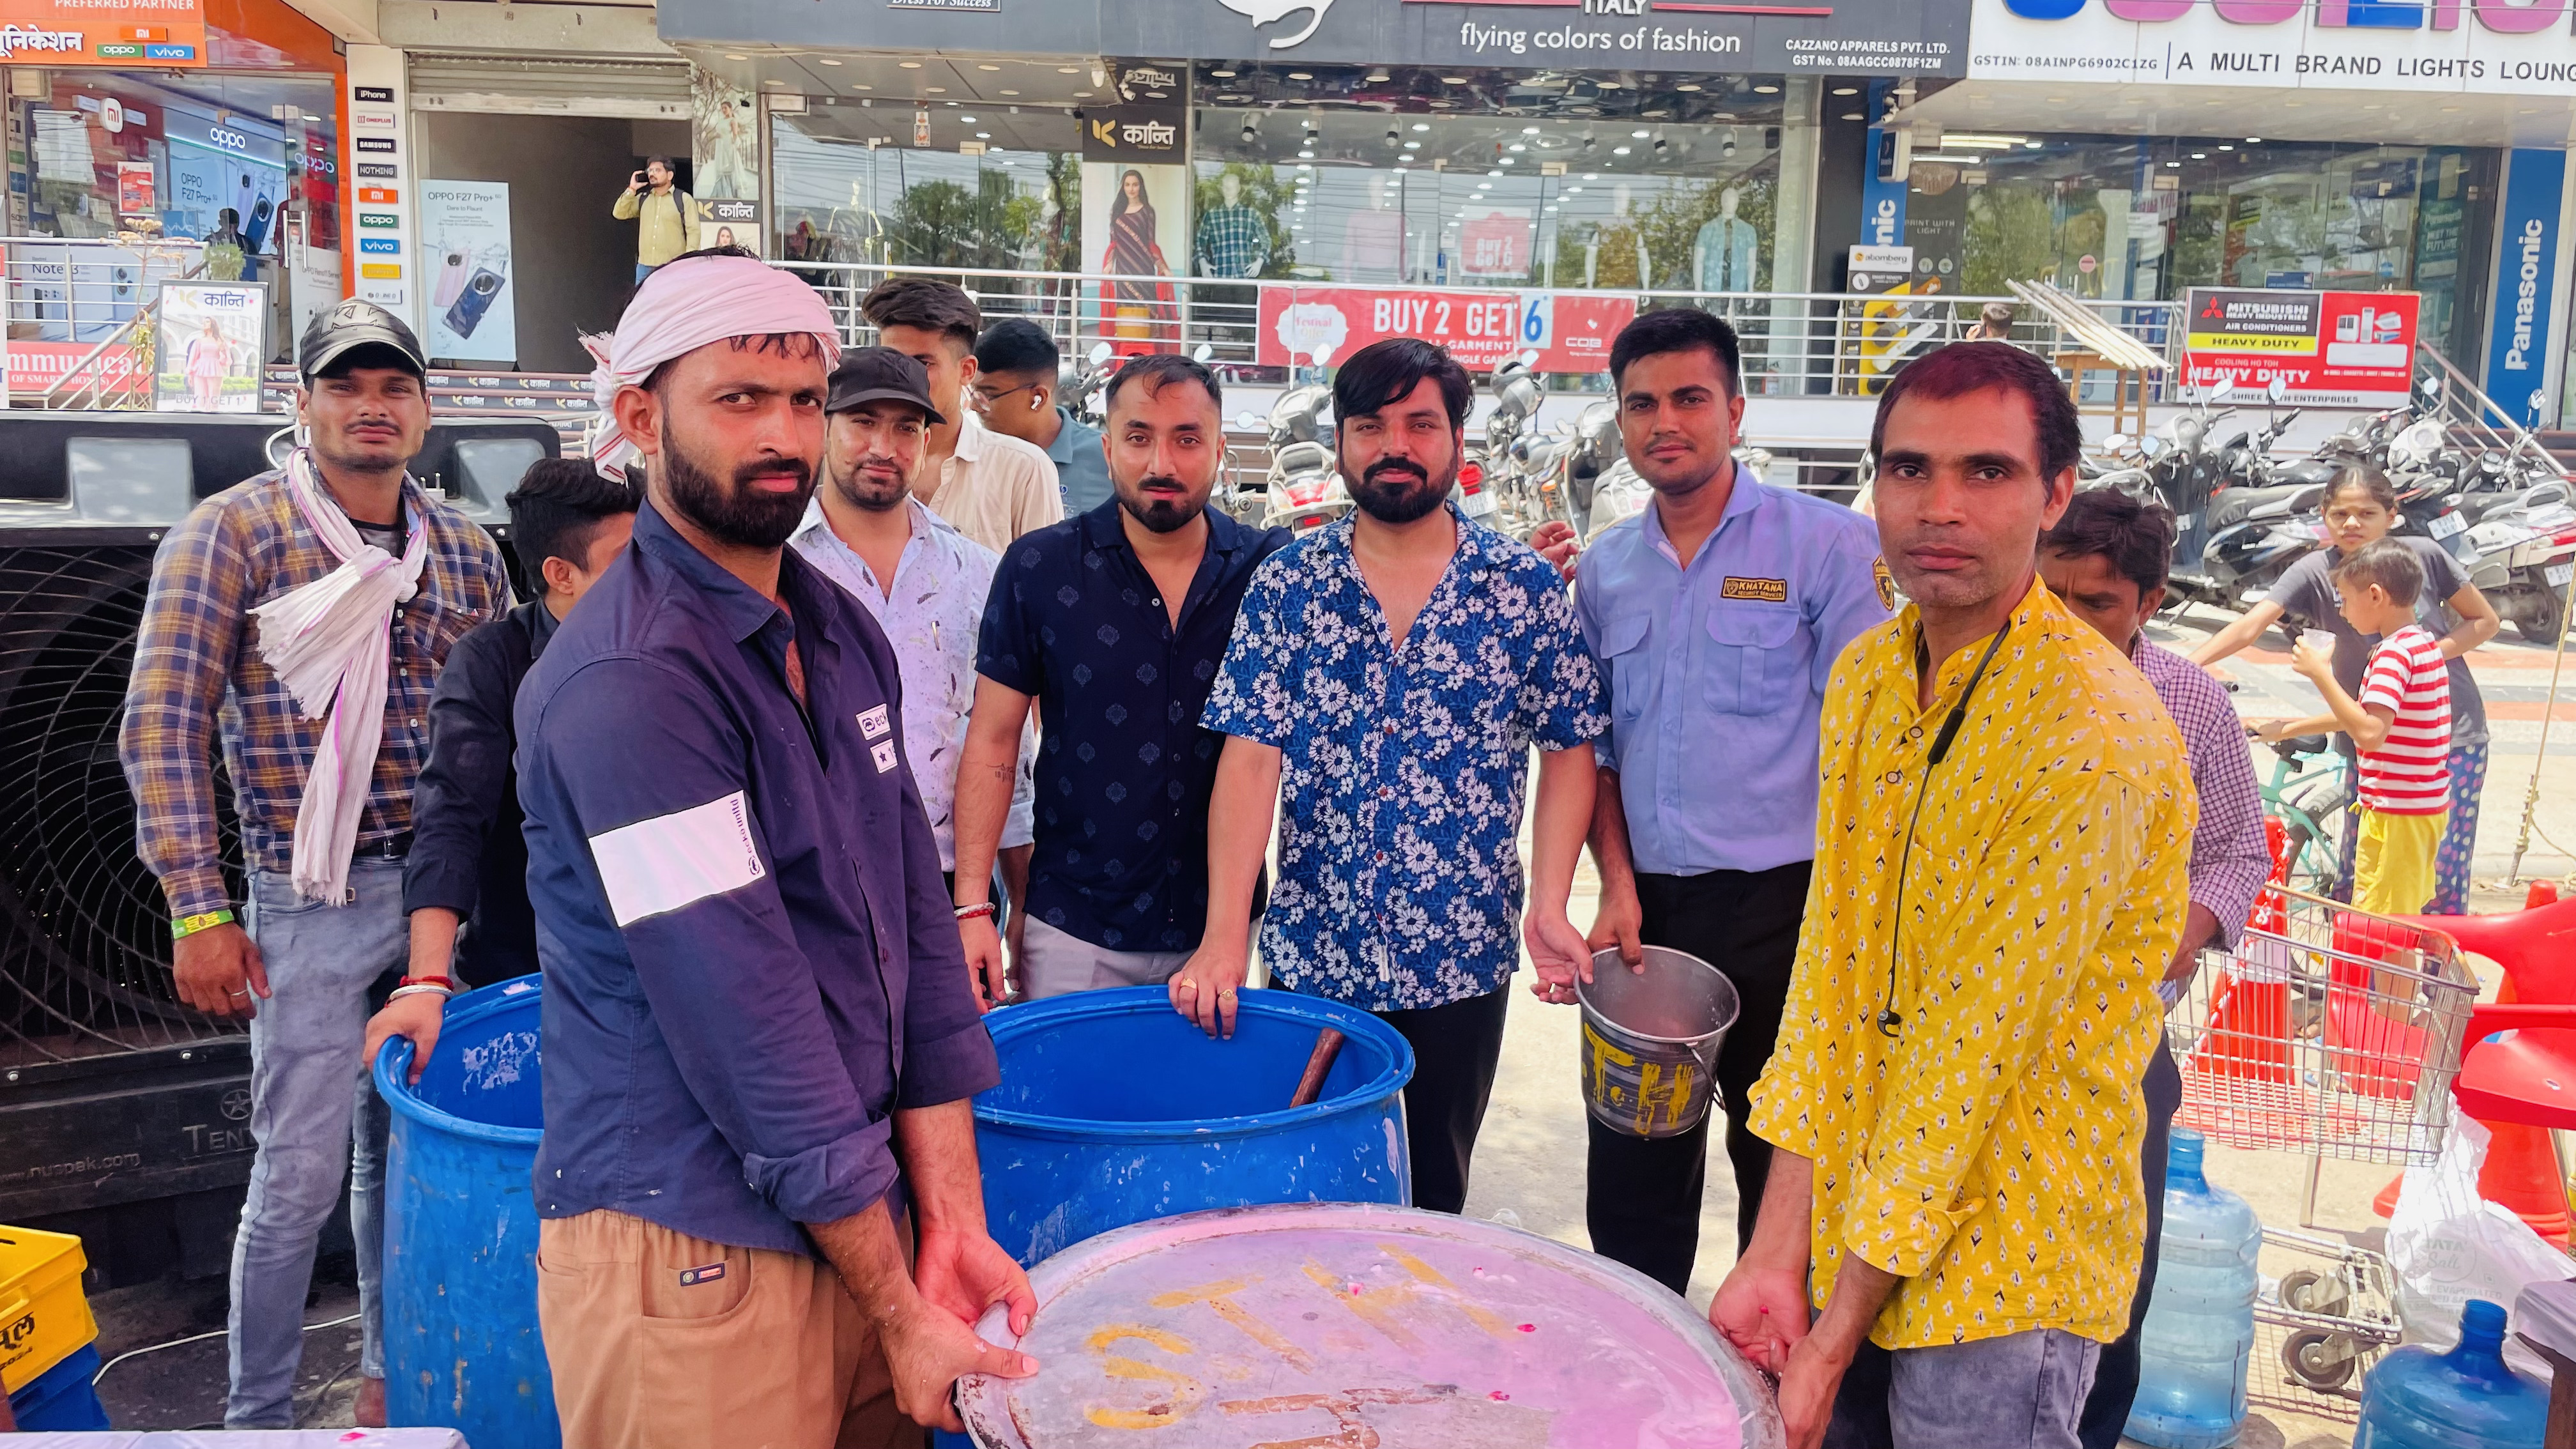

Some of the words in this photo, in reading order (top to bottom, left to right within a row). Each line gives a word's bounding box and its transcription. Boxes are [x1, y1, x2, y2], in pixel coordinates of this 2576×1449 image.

[55, 0, 128, 8] PREFERRED
[134, 0, 194, 10] PARTNER
[1583, 0, 1647, 16] ITALY
[1460, 22, 1526, 54] flying
[1533, 25, 1612, 50] colors
[1619, 27, 1647, 50] of
[1652, 27, 1740, 53] fashion
[155, 47, 185, 57] vivo
[1785, 39, 1839, 51] CAZZANO
[1840, 40, 1898, 53] APPARELS
[1901, 42, 1924, 54] PVT.
[1926, 42, 1951, 54] LTD.
[1792, 55, 1815, 66] GST
[1817, 55, 1835, 66] No.
[1974, 56, 2021, 66] GSTIN:
[2177, 52, 2194, 70] A
[2211, 53, 2279, 72] MULTI
[2295, 55, 2381, 75] BRAND
[2397, 58, 2485, 77] LIGHTS
[360, 90, 387, 99] iPhone
[1122, 120, 1176, 145] कान्ति
[359, 166, 394, 176] NOTHING
[181, 172, 203, 188] OPPO
[181, 187, 194, 200] F27
[196, 191, 211, 204] Pro+
[428, 192, 454, 201] OPPO
[456, 193, 472, 201] F27
[474, 194, 494, 202] Pro+
[717, 201, 755, 218] कान्ति
[1933, 219, 1955, 227] WITH
[365, 241, 394, 250] vivo
[1505, 236, 1513, 251] 2
[1865, 254, 1908, 263] atomberg
[33, 264, 64, 275] Note
[204, 291, 245, 308] कान्ति
[2505, 218, 2543, 370] Panasonic
[2226, 302, 2309, 314] MITSUBISHI
[1374, 298, 1430, 334] BUY
[1434, 300, 1451, 335] 2
[1466, 302, 1519, 337] GET
[1524, 300, 1543, 343] 6
[2255, 313, 2308, 321] INDUSTRIES
[2225, 322, 2240, 330] AIR
[2242, 323, 2306, 332] CONDITIONERS
[2212, 337, 2257, 347] HEAVY
[2262, 339, 2299, 348] DUTY
[2214, 358, 2249, 366] COOLING
[12, 374, 26, 383] OF
[2187, 367, 2251, 382] HEAVY
[2256, 369, 2310, 383] DUTY
[530, 379, 551, 388] कान्ति
[176, 394, 199, 404] BUY
[211, 395, 231, 405] GET
[236, 397, 240, 406] 1
[463, 395, 485, 406] कान्ति
[515, 397, 537, 408] कान्ति
[567, 399, 588, 408] कान्ति
[2232, 393, 2262, 401] SHREE
[2294, 394, 2358, 404] ENTERPRISES
[1739, 581, 1782, 592] KHATANA
[730, 799, 743, 827] unltd
[740, 829, 752, 853] ecko
[2437, 1285, 2502, 1300] EVAPORATED
